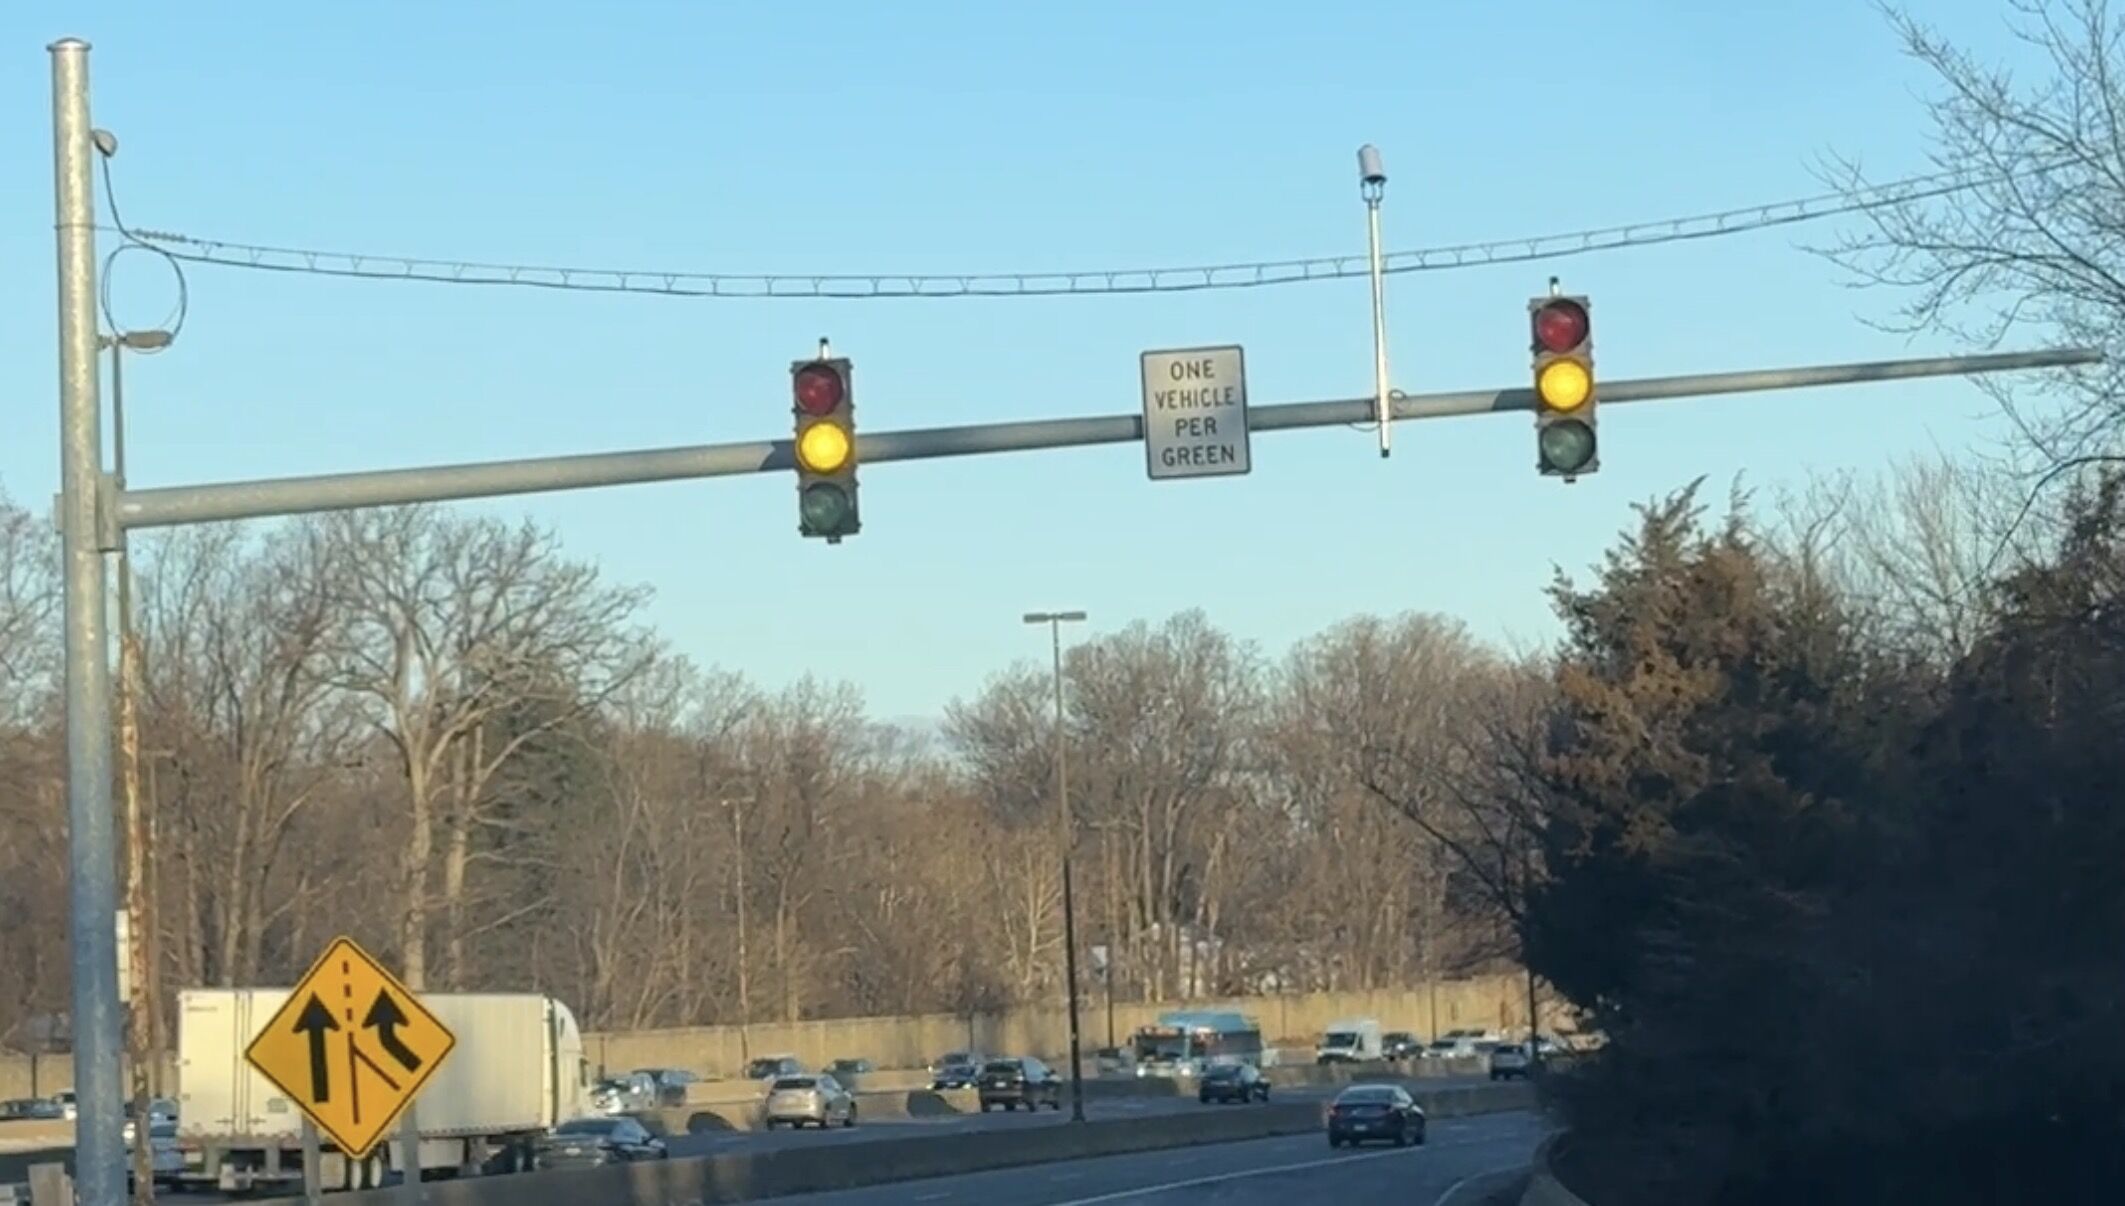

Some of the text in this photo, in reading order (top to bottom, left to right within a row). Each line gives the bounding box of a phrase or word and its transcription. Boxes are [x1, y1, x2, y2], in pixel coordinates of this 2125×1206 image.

[1170, 359, 1215, 381] ONE
[1154, 386, 1235, 409] VEHICLE
[1175, 416, 1217, 437] PER
[1161, 444, 1235, 467] GREEN
